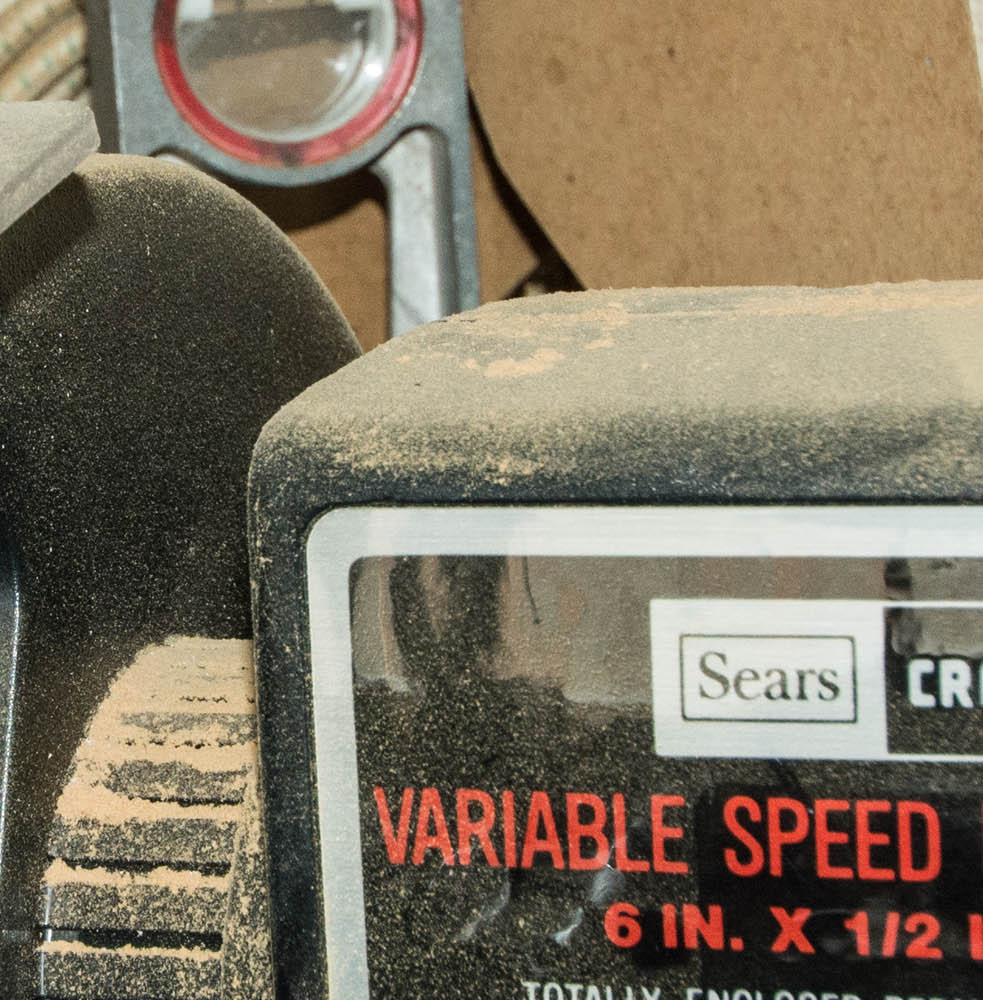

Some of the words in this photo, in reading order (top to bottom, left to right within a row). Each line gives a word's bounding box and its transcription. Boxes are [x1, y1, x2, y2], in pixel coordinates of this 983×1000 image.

[699, 651, 840, 701] Sears
[907, 658, 983, 709] CR
[373, 786, 689, 874] VARIABLE
[723, 795, 942, 882] SPEED
[604, 902, 643, 948] 6
[661, 904, 744, 951] IN.
[770, 906, 815, 954] X
[844, 912, 944, 959] 1/2
